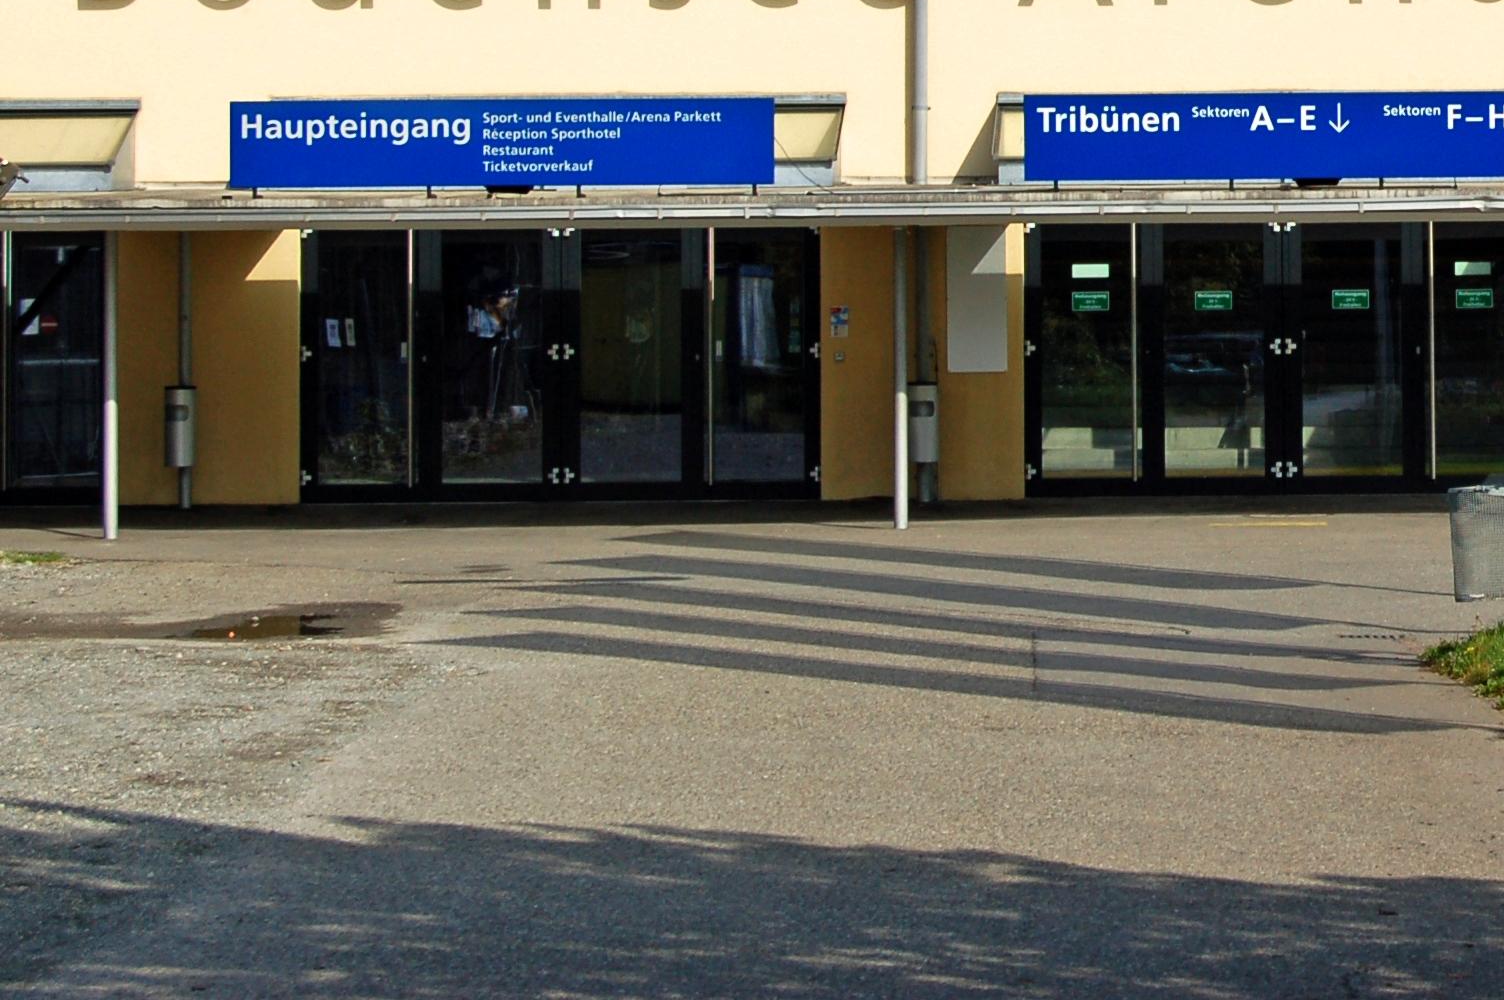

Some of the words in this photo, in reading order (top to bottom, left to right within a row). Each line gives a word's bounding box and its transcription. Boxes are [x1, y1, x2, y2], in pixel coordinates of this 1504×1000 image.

[1192, 106, 1249, 118] Sektoren
[1384, 105, 1441, 117] Sektoren
[483, 112, 522, 126] Sport-
[526, 111, 552, 123] und
[675, 111, 721, 122] Parkett
[1037, 105, 1179, 132] Tribünen
[242, 112, 471, 146] Haupteingang
[483, 128, 547, 142] Réception
[551, 127, 621, 142] Sporthotel
[483, 145, 554, 156] Restaurant
[483, 160, 593, 172] Ticketvorverkauf
